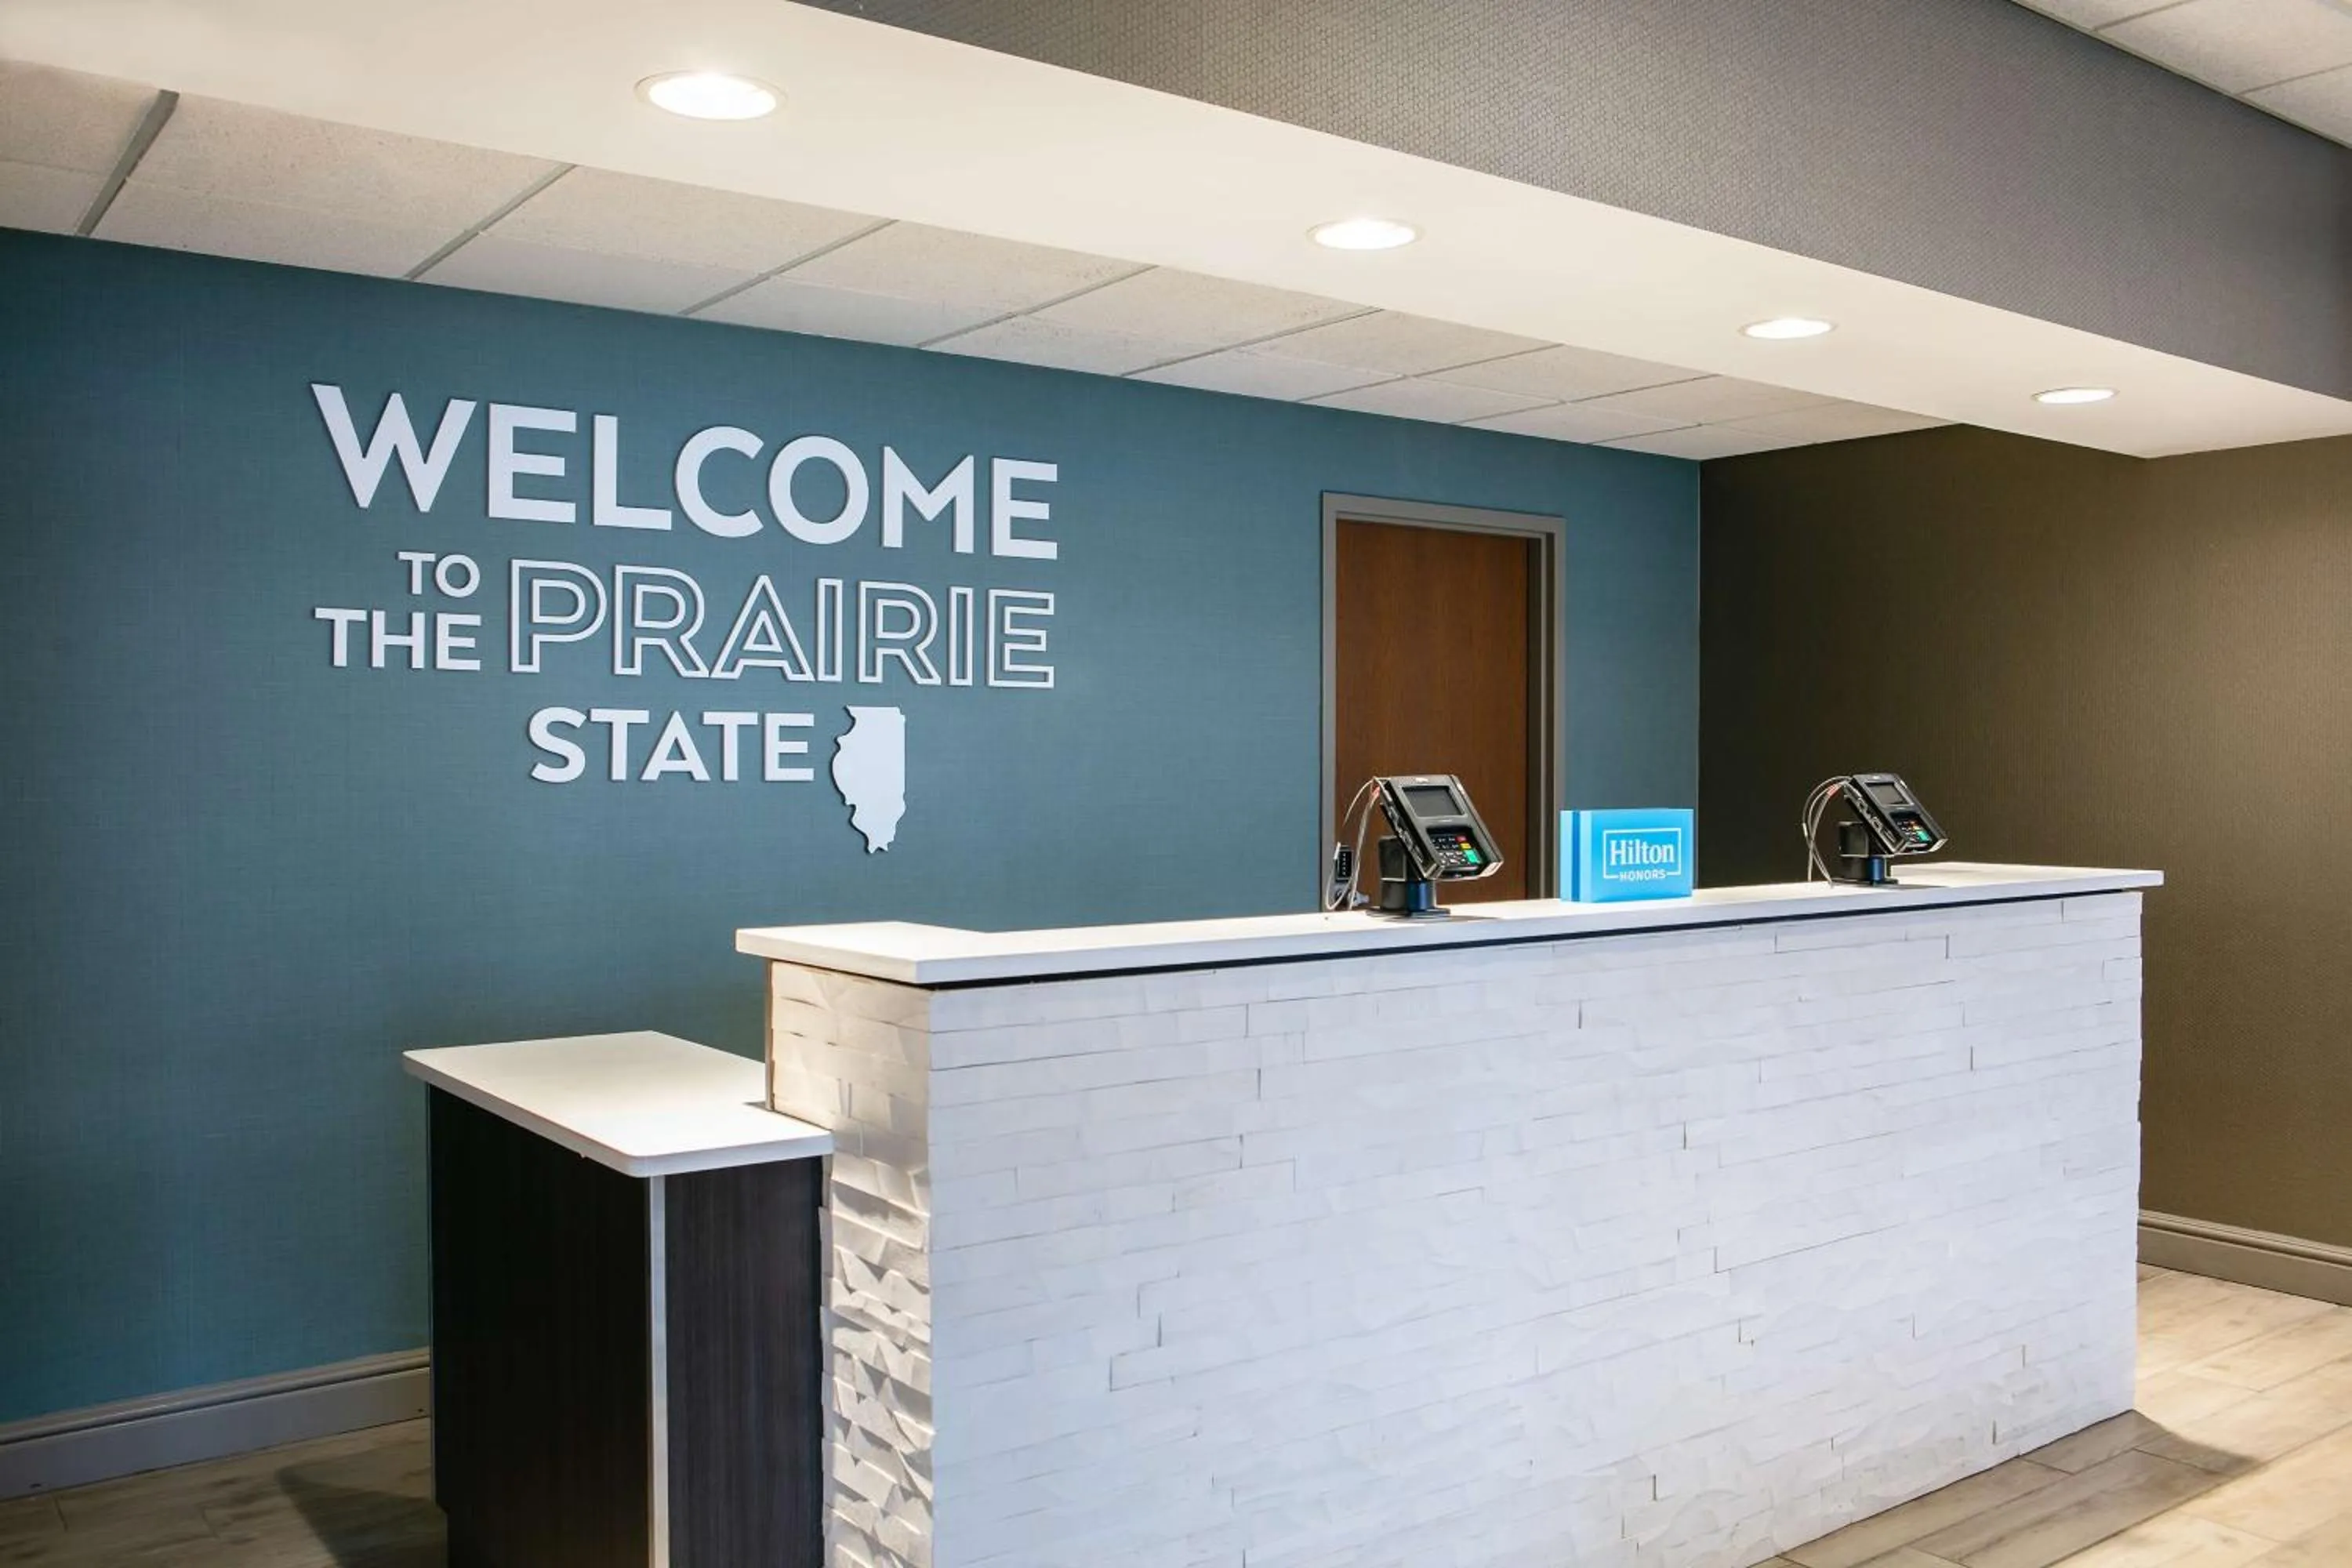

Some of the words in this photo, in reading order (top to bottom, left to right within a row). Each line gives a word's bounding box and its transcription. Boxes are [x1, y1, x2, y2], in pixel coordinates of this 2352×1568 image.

[311, 383, 1058, 560] WELCOME
[397, 551, 481, 598] TO
[314, 608, 481, 672] THE
[510, 558, 1055, 689] PRAIRIE
[528, 706, 815, 783] STATE
[1610, 839, 1675, 866] Hilton
[1618, 869, 1667, 882] HONORS
